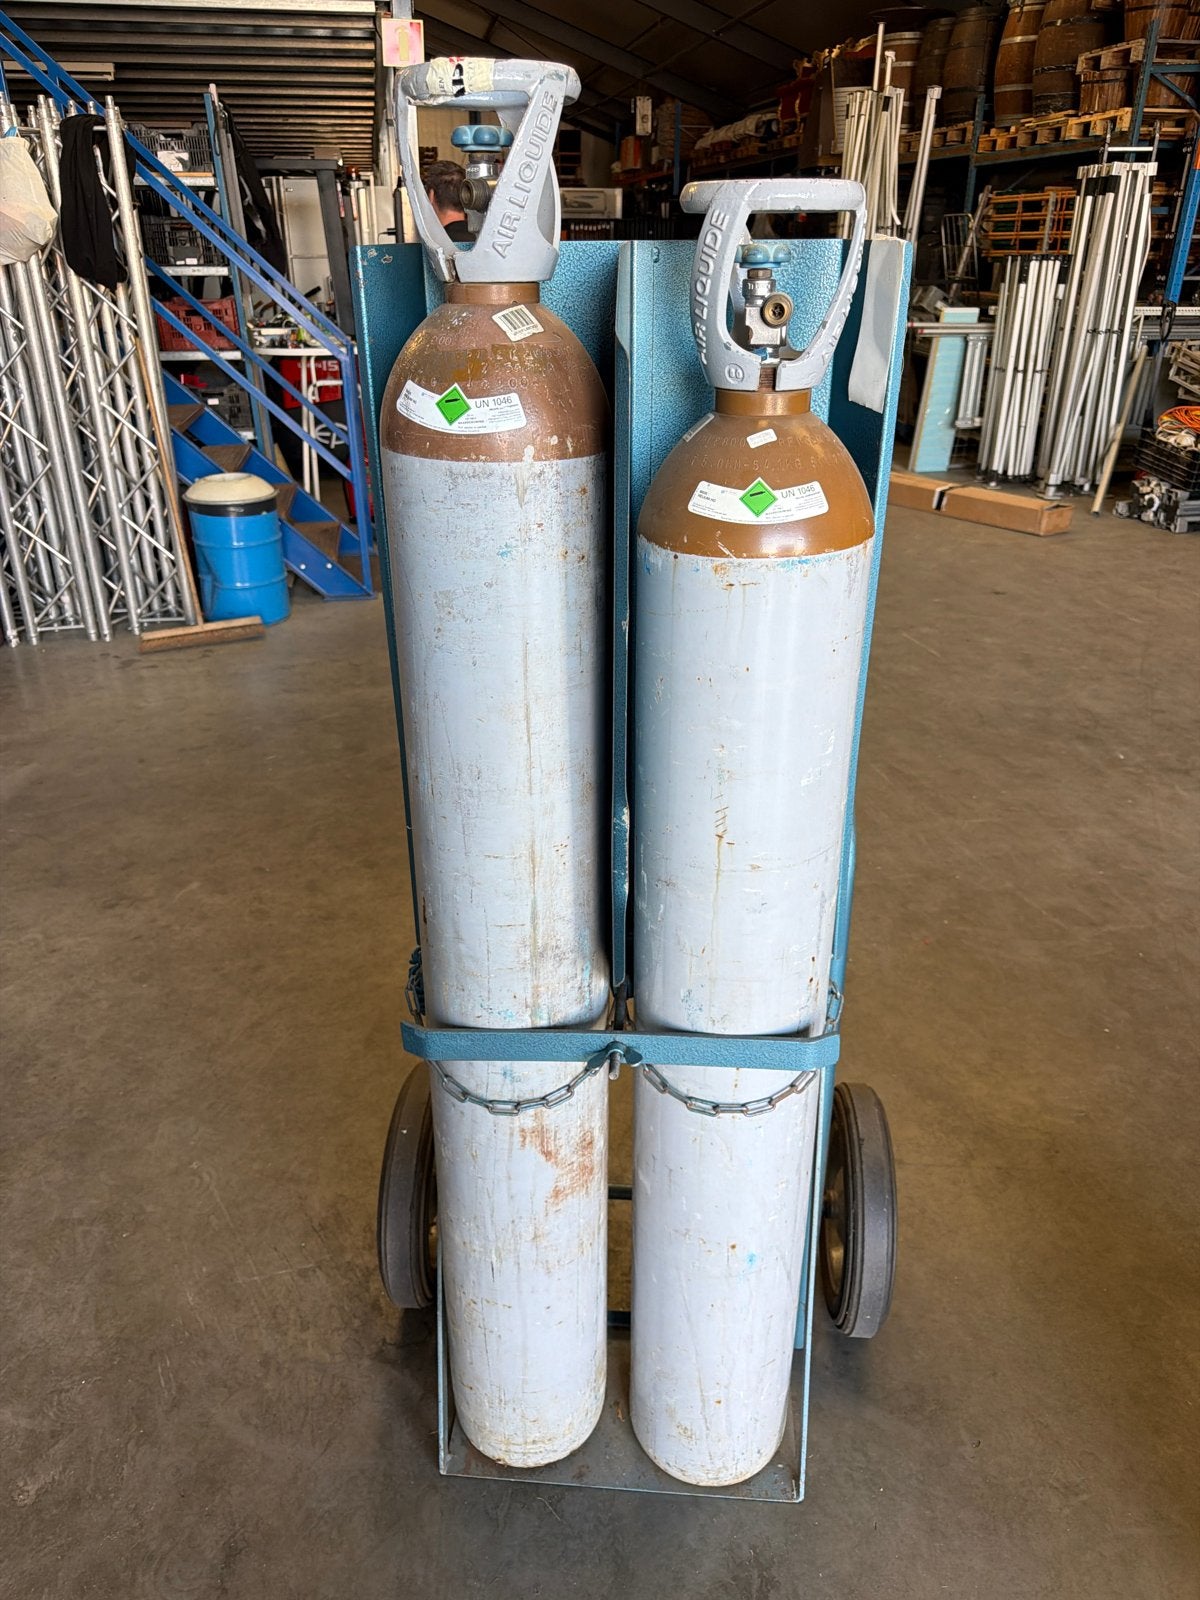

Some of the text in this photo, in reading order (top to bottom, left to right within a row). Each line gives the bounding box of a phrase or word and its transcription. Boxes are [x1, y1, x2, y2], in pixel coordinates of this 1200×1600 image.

[492, 90, 558, 259] AIR LIQUIDE
[694, 208, 730, 322] LIQUIDE
[474, 399, 490, 409] UN
[491, 395, 513, 407] 1046
[780, 489, 796, 499] UN
[797, 484, 815, 495] 1046
